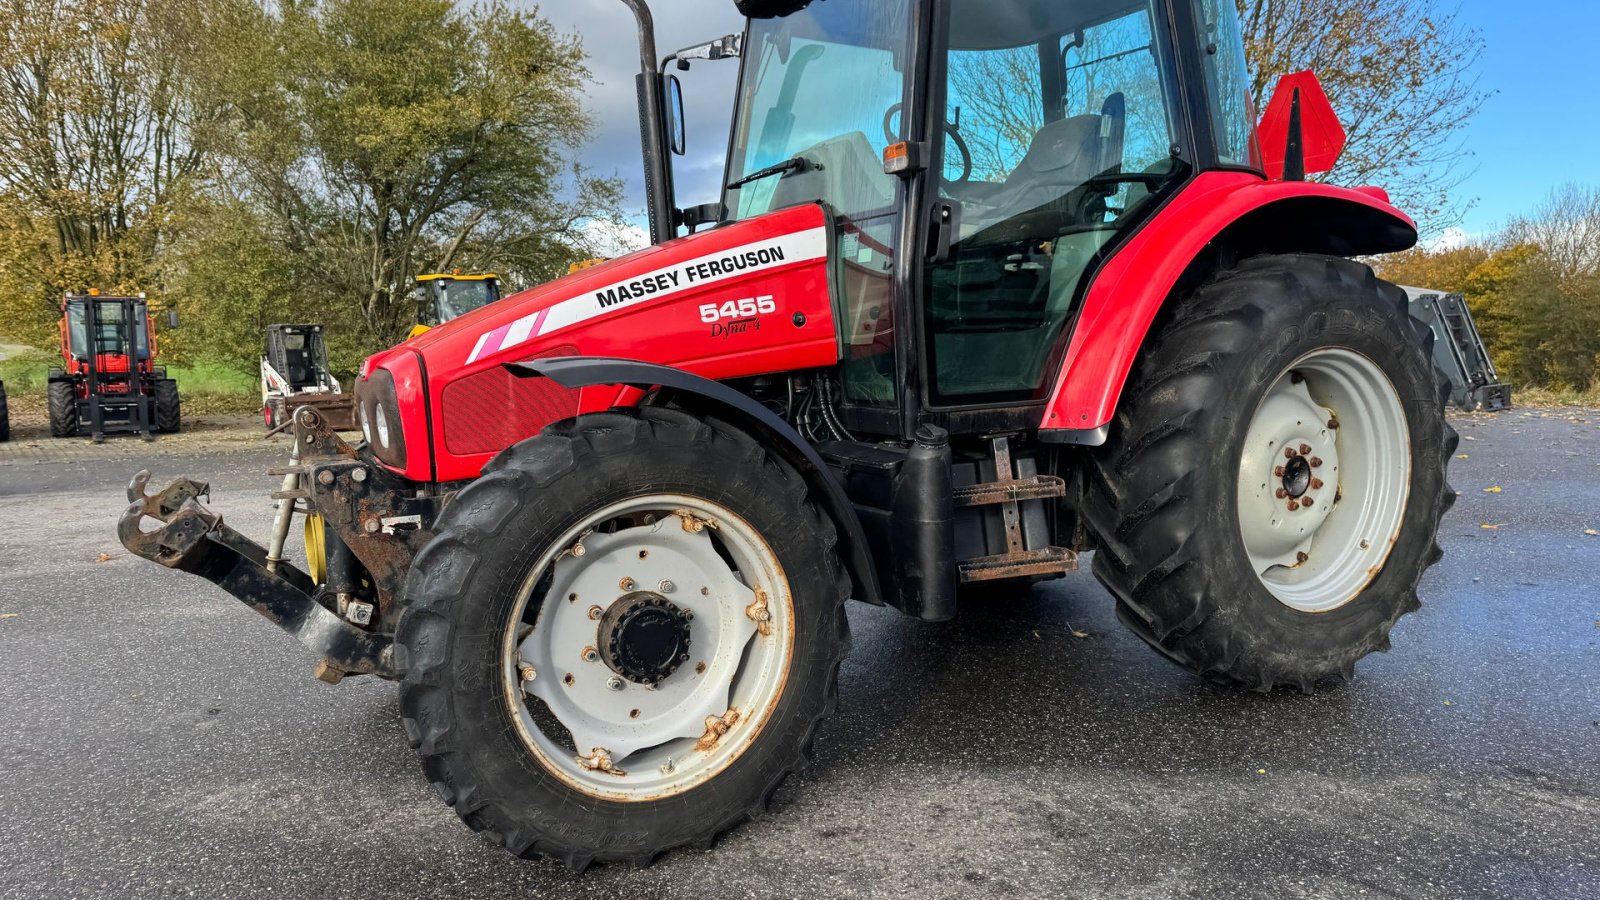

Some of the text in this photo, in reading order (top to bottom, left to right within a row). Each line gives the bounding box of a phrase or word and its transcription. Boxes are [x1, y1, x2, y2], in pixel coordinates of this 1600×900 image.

[596, 246, 785, 308] MASSEY FERGUSON
[699, 294, 776, 323] 5455
[711, 318, 760, 340] Dyna-4
